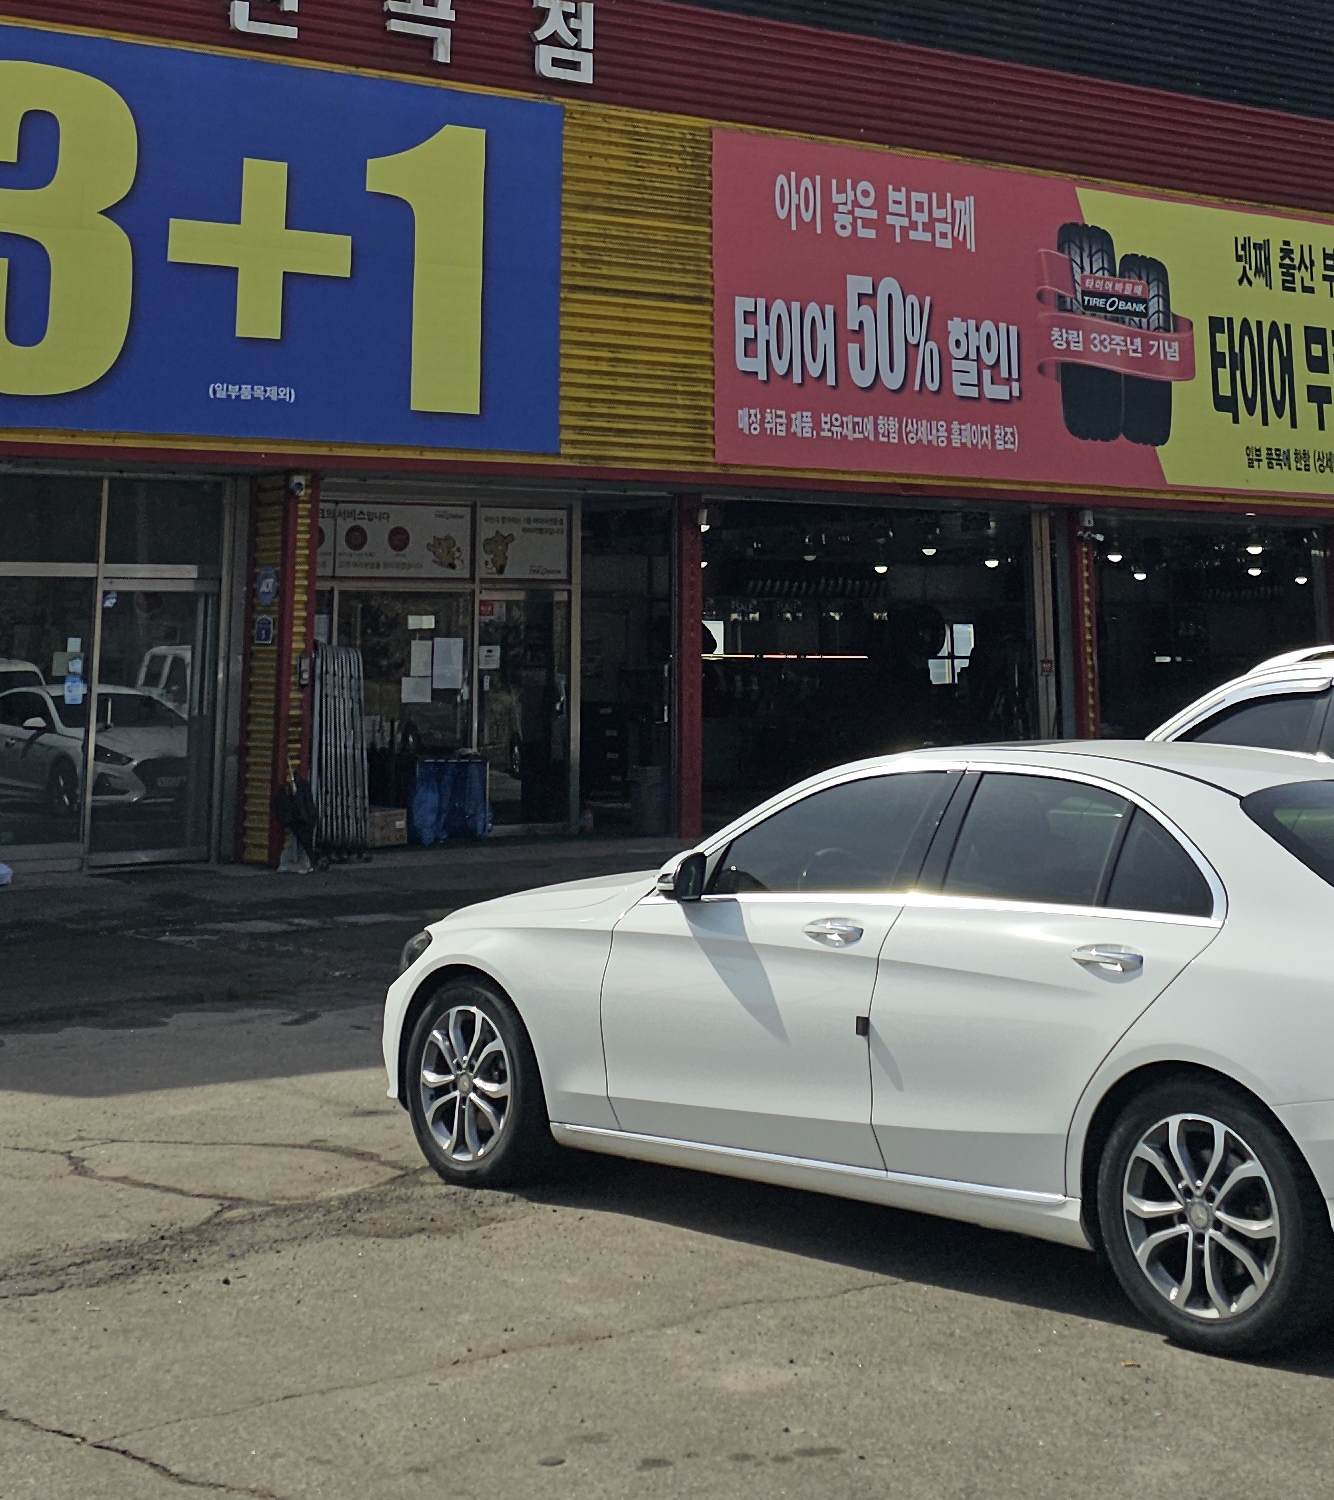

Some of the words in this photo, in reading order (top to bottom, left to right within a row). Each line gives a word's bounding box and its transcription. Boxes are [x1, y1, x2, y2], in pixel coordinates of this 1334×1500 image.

[775, 171, 822, 235] 아이
[831, 178, 878, 239] 낳은
[886, 184, 976, 252] 부모님께
[1234, 236, 1272, 290] 넷째
[1278, 239, 1316, 294] 출산
[734, 296, 836, 386] 타이어
[846, 274, 940, 391] 50%
[947, 317, 1020, 400] 할인!
[1051, 327, 1083, 351] 창립
[1090, 333, 1142, 357] 33주년
[1149, 339, 1180, 362] 기념
[209, 383, 295, 403] (일부품목제외)
[1208, 315, 1298, 429] 타이어
[738, 407, 761, 435] 매장
[764, 408, 787, 436] 취급
[791, 411, 817, 439] 제품,
[877, 415, 899, 443] 한함
[902, 416, 947, 447] (상세내용
[951, 420, 992, 449] 홈페이지
[994, 423, 1019, 452] 참조)
[1245, 445, 1262, 469] 일부
